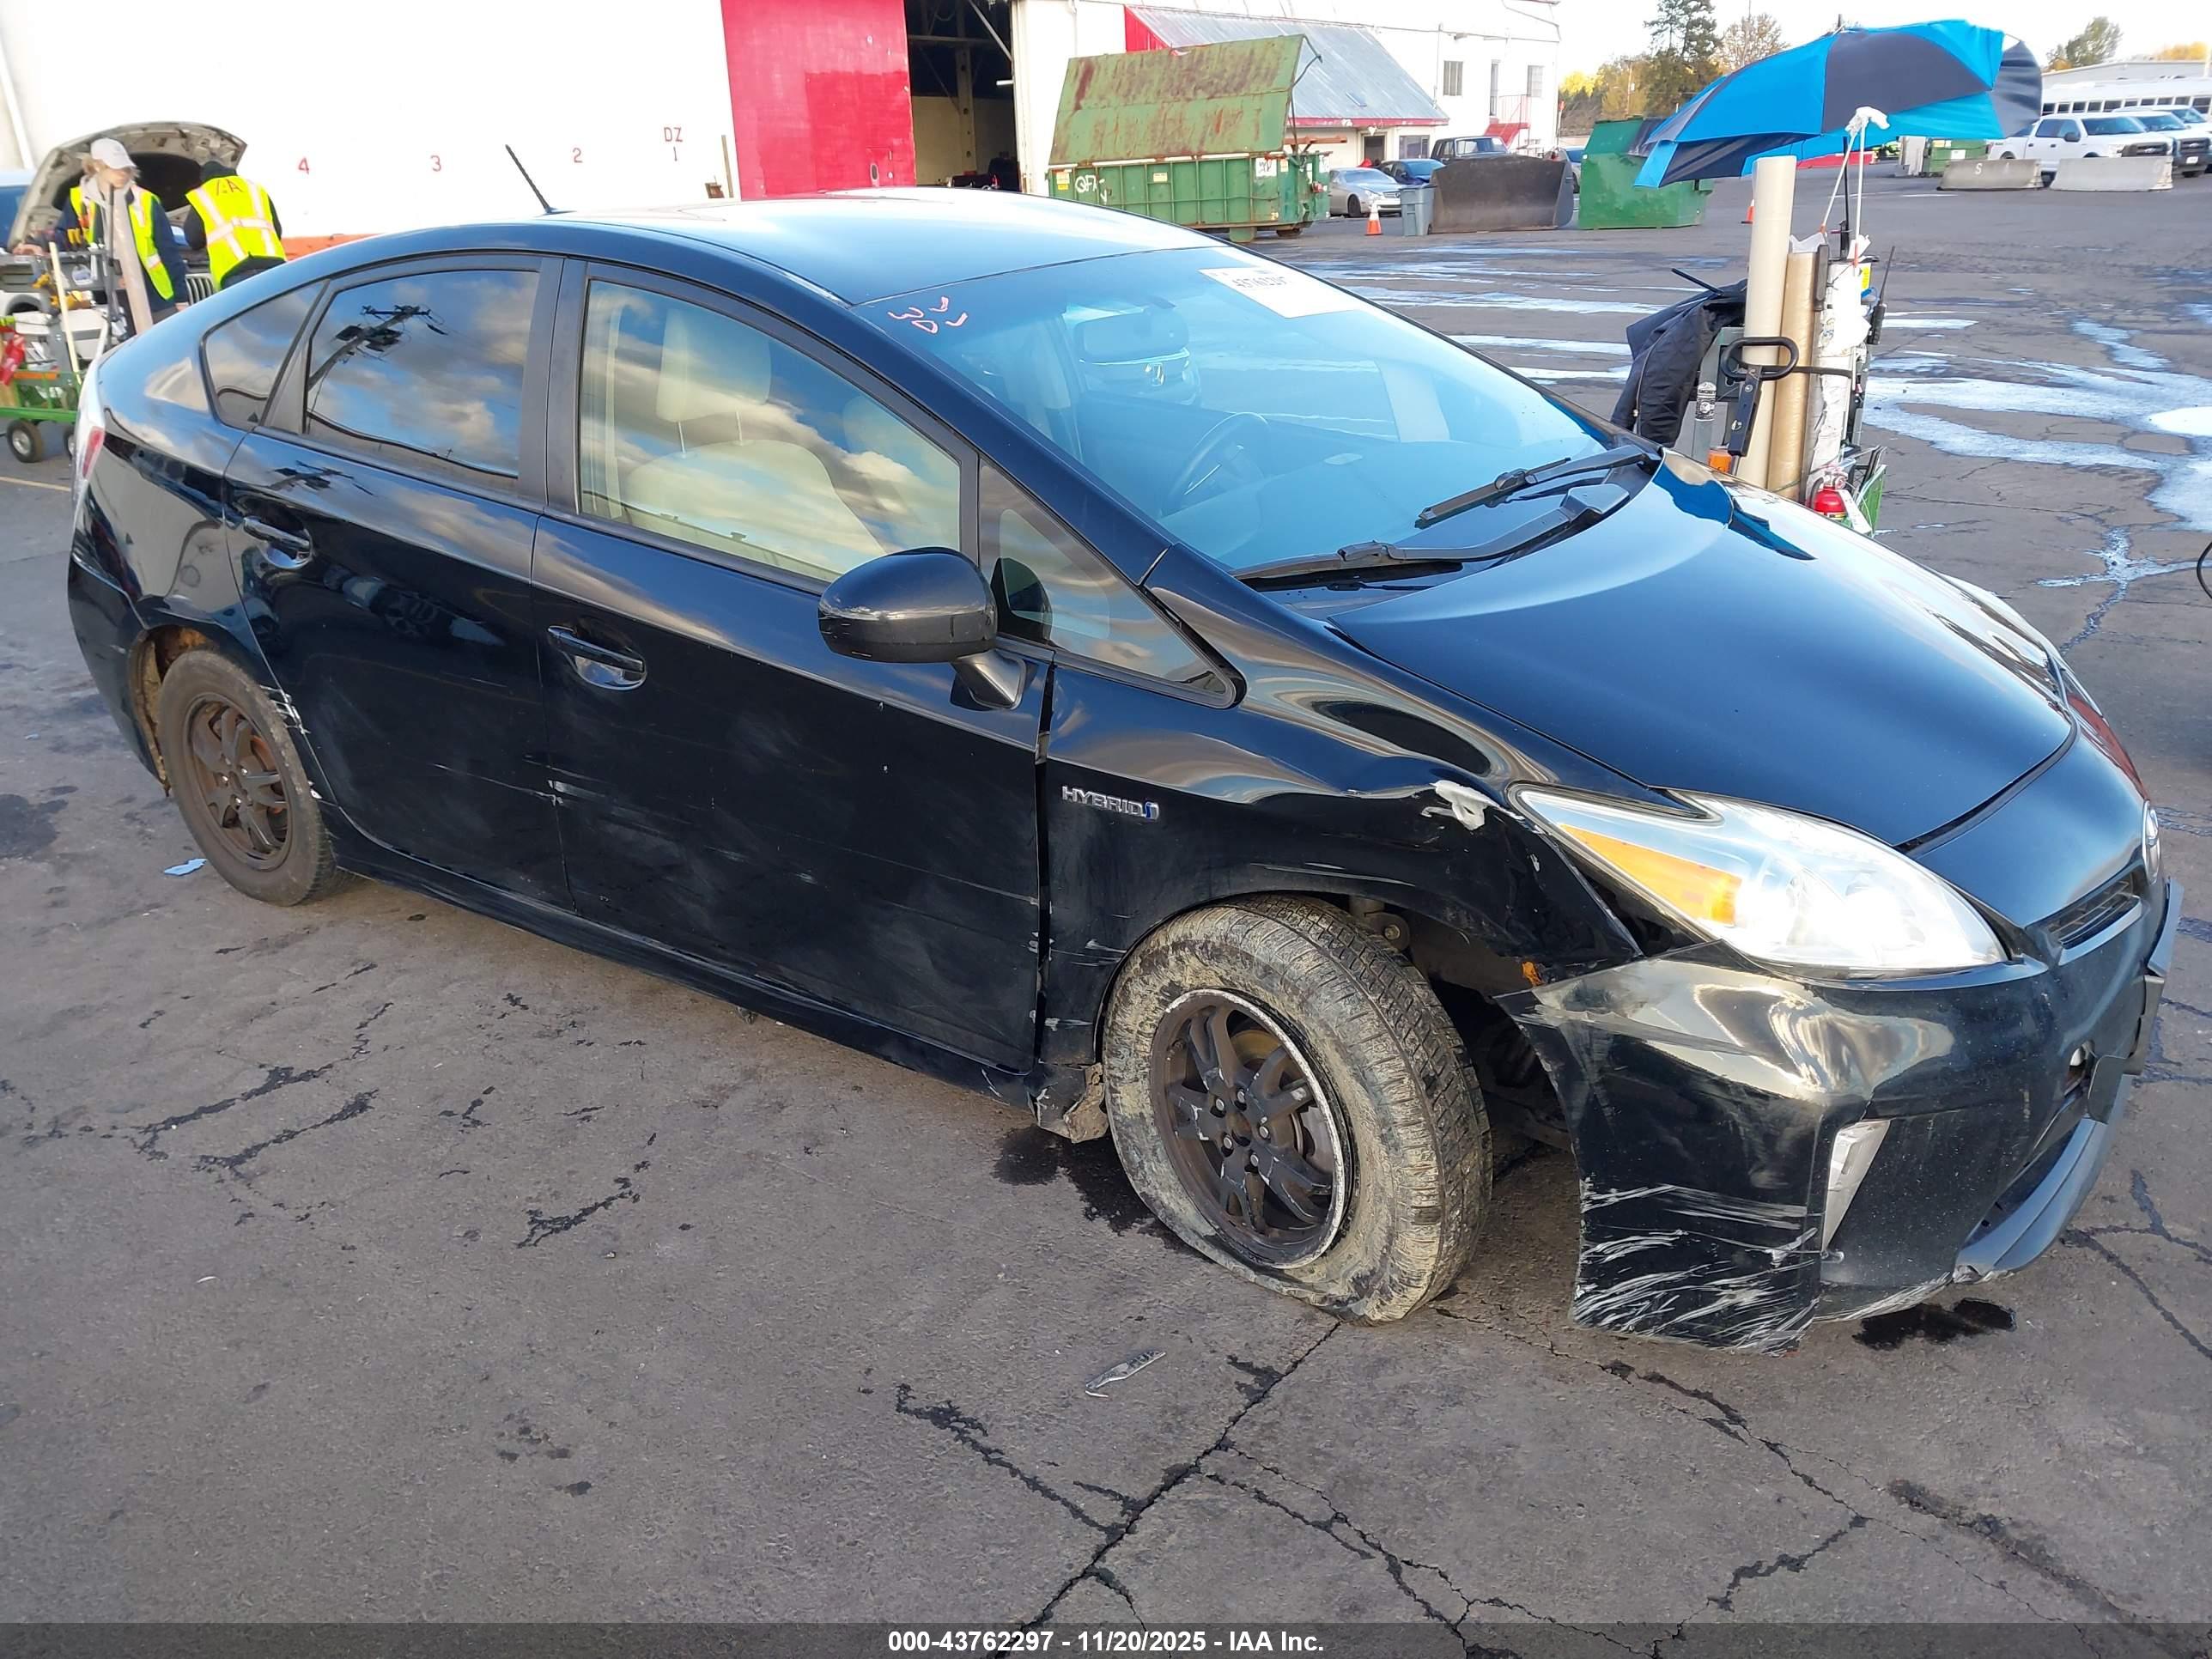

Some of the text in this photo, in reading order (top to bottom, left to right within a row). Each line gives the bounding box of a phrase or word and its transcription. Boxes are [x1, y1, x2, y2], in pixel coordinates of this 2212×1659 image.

[663, 126, 684, 143] DZ
[430, 155, 441, 172] 3
[572, 147, 583, 163] 2
[298, 156, 310, 175] 4
[1061, 785, 1146, 817] HYBRID
